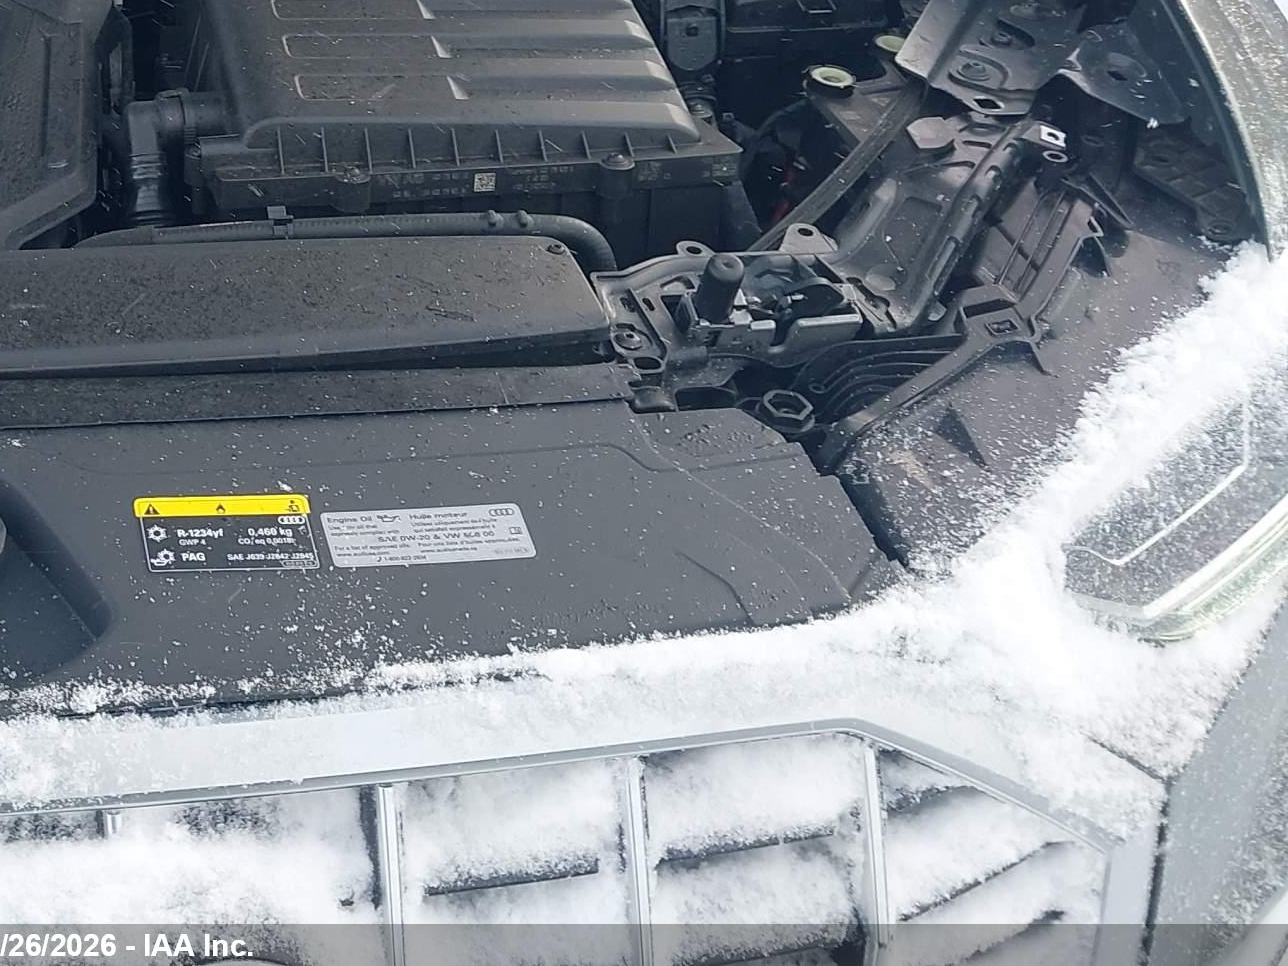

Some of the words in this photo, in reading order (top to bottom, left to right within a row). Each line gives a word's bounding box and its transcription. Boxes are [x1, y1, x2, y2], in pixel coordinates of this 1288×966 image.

[326, 516, 358, 524] Engine
[176, 528, 224, 539] R-1234yf
[278, 526, 293, 537] kg
[180, 551, 205, 561] PAG
